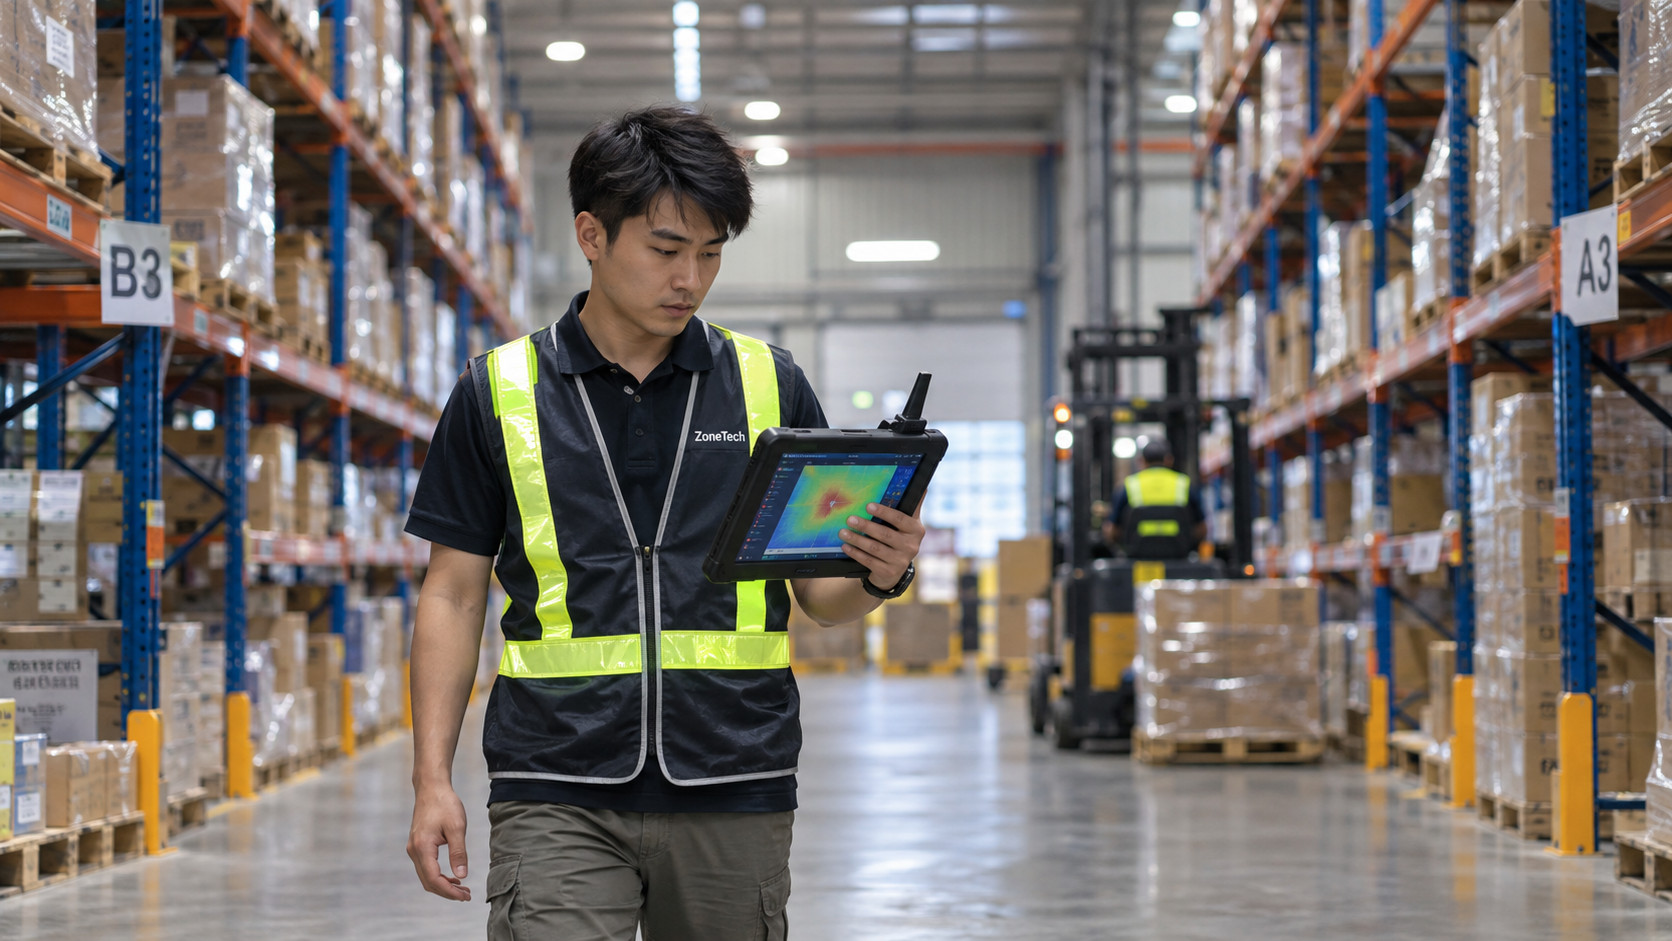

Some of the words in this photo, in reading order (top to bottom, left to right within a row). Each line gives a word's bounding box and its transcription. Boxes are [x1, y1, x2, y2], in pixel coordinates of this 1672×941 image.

[110, 246, 162, 299] B3
[1577, 235, 1611, 297] A3
[694, 430, 746, 442] ZoneTech
